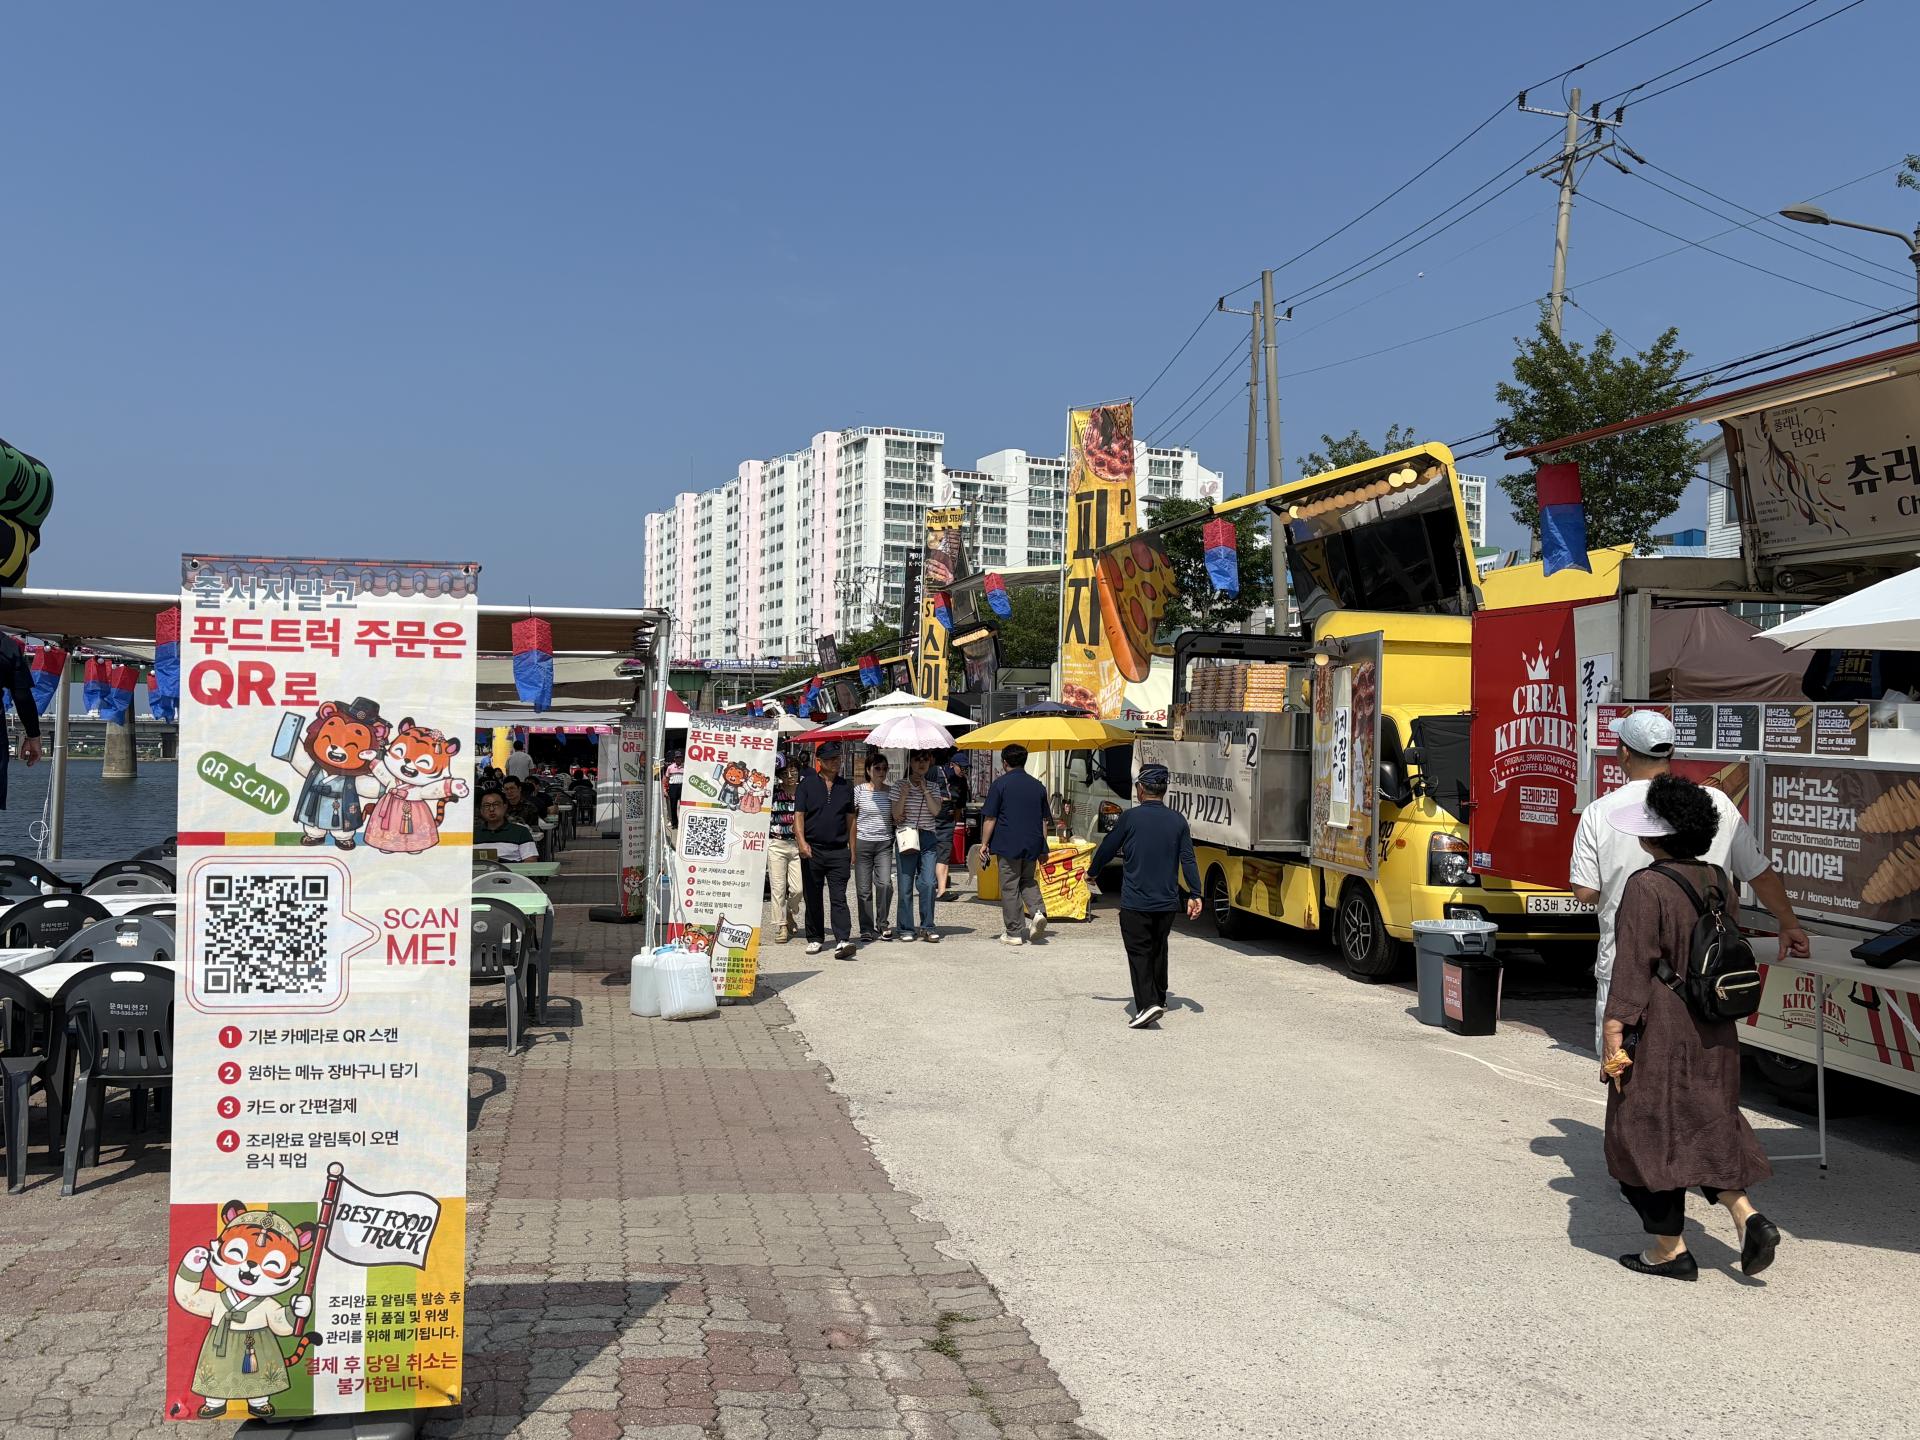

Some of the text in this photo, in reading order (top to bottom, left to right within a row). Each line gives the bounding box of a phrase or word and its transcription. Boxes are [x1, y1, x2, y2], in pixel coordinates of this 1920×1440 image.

[1791, 427, 1826, 448] 단오다
[191, 575, 358, 611] 줄서지말고
[190, 616, 467, 659] 푸드트럭 주문은
[188, 659, 320, 709] QR로
[1512, 683, 1569, 716] CREA
[1121, 708, 1168, 721] Freeze B
[1766, 708, 1790, 717] 바삭고소
[1818, 709, 1844, 718] 바삭고소
[689, 730, 775, 751] 푸드트럭 주문은
[1246, 732, 1257, 767] 2
[688, 744, 729, 763] QR로
[1520, 764, 1538, 772] COFFEE
[201, 757, 284, 810] QR SCAN
[699, 782, 716, 795] SCAN
[1193, 774, 1233, 792] HUNGRYBEAR
[1772, 776, 1839, 804] 바삭고소
[1169, 790, 1232, 826] 피자 PIZZA
[1771, 800, 1857, 832] 회오리감자
[742, 830, 766, 840] SCAN
[1772, 830, 1860, 851] Crunchy Tornado Potato
[742, 839, 764, 852] ME!
[1771, 848, 1844, 882] 5.000원
[1534, 898, 1559, 912] 83버
[1807, 890, 1832, 907] Honey
[1833, 893, 1861, 910] butter
[383, 907, 459, 930] SCAN
[720, 926, 751, 938] BEST FOOD
[728, 935, 747, 946] TRUCK
[386, 932, 457, 967] ME!
[1795, 976, 1833, 999] CRA
[248, 1029, 277, 1045] 기본
[281, 1028, 339, 1045] 카메라로
[343, 1030, 366, 1044] QR
[369, 1027, 398, 1043] 스캔
[248, 1064, 292, 1081] 원하는
[295, 1064, 324, 1080] 메뉴
[327, 1062, 386, 1079] 장바구니
[389, 1062, 418, 1079] 담기
[247, 1099, 277, 1115] 카드
[279, 1102, 295, 1114] or
[299, 1098, 357, 1114] 간편결제
[245, 1132, 305, 1148] 조리완료
[308, 1131, 366, 1147] 알림톡이
[369, 1130, 399, 1146] 오면
[245, 1153, 307, 1169] 음식 픽업
[337, 1203, 433, 1233] BEST FOOD
[361, 1225, 428, 1255] TRUCK
[328, 1290, 461, 1309] 조리완료 알림톡 발송 후
[331, 1309, 449, 1326] 30분 뒤 품질 및 위생
[325, 1326, 459, 1345] 관리를 위해 폐기됩니다.
[304, 1351, 458, 1377] 결제 후 당일 취소는
[336, 1375, 430, 1395] 불가합니다.
